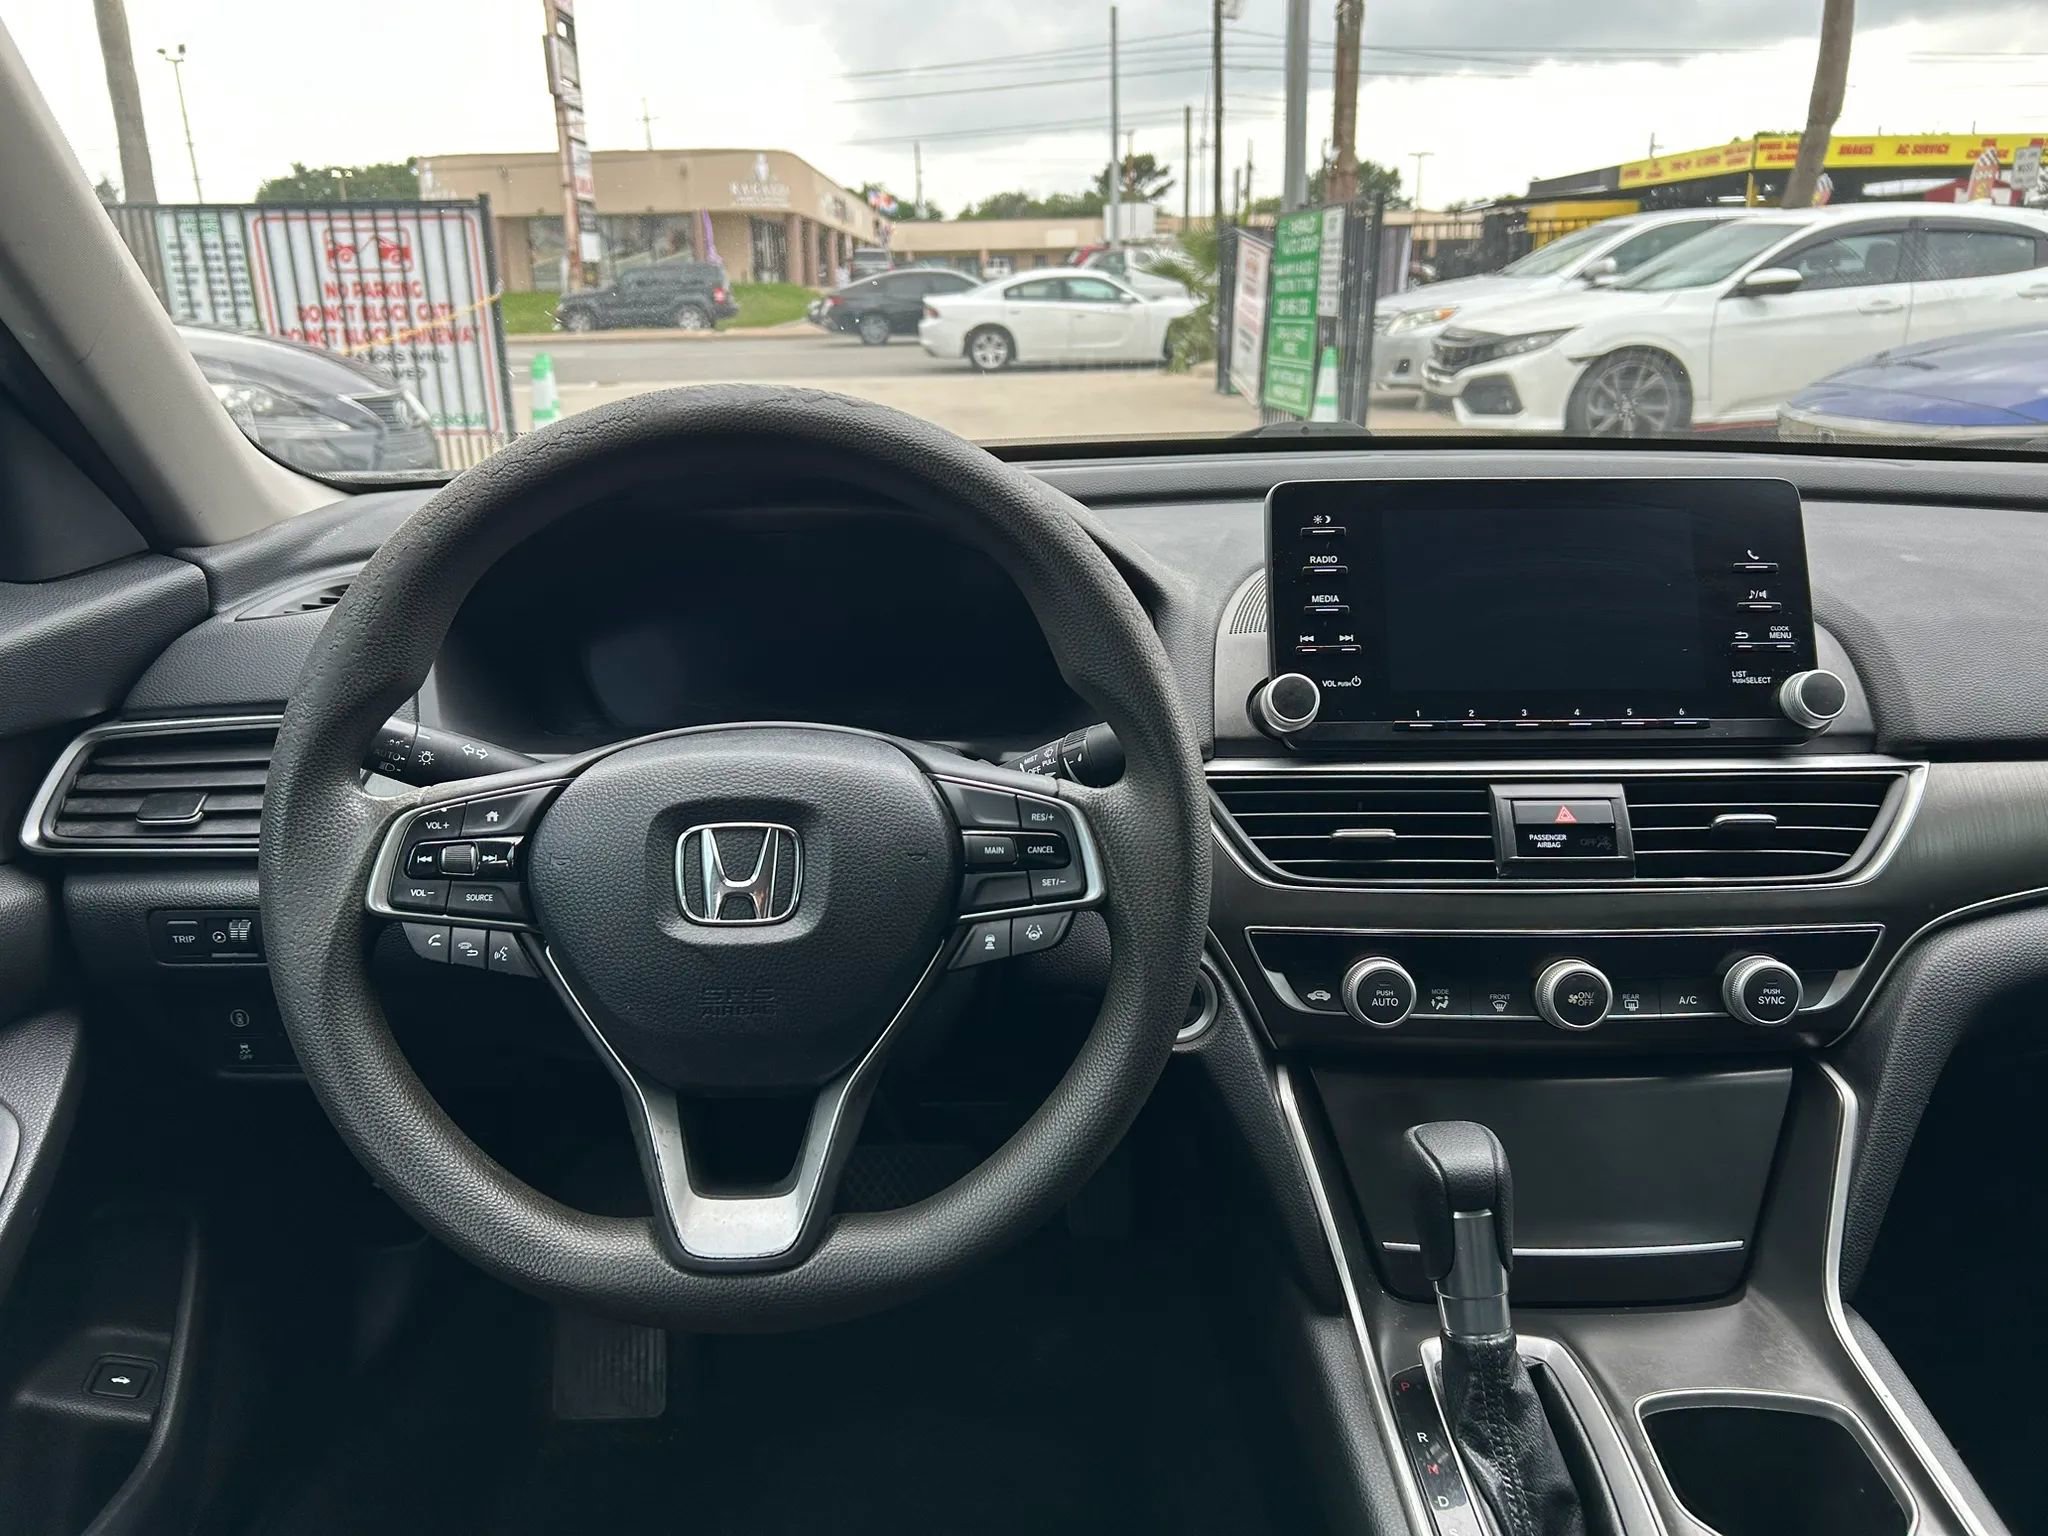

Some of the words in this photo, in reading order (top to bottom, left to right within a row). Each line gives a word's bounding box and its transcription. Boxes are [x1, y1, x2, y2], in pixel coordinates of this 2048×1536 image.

[324, 280, 348, 298] NO
[352, 280, 423, 298] PARKING
[297, 304, 321, 323] DO
[322, 304, 356, 322] NOT
[361, 304, 411, 322] BLOCK
[1309, 555, 1338, 564] RADIO
[1311, 594, 1340, 603] MEDIA
[1321, 680, 1337, 688] VOL
[1415, 709, 1421, 718] 1
[1468, 709, 1476, 717] 2
[1521, 709, 1528, 717] 3
[1573, 708, 1580, 716] 4
[1626, 708, 1633, 716] 5
[1678, 708, 1685, 716] 6
[1023, 754, 1039, 765] MIST
[1041, 757, 1057, 767] PULL
[1027, 765, 1042, 775] OFF
[1031, 813, 1055, 822] RES/+
[1528, 833, 1568, 841] PASSENGER
[1536, 841, 1562, 849] AIRBAG
[984, 846, 1005, 855] MAIN
[1026, 846, 1055, 854] CANCEL
[465, 893, 494, 902] SOURCE
[172, 935, 196, 944] TRIP
[1375, 989, 1394, 997] PUSH
[1431, 988, 1449, 996] MODE
[1577, 991, 1595, 1000] ON/
[1489, 993, 1511, 1001] FRONT
[1678, 995, 1698, 1005] A/C
[1757, 995, 1786, 1005] SYNC
[1371, 998, 1399, 1007] AUTO
[1401, 1381, 1410, 1391] P
[1416, 1431, 1429, 1443] R
[1426, 1463, 1440, 1475] N
[1437, 1495, 1450, 1507] D
